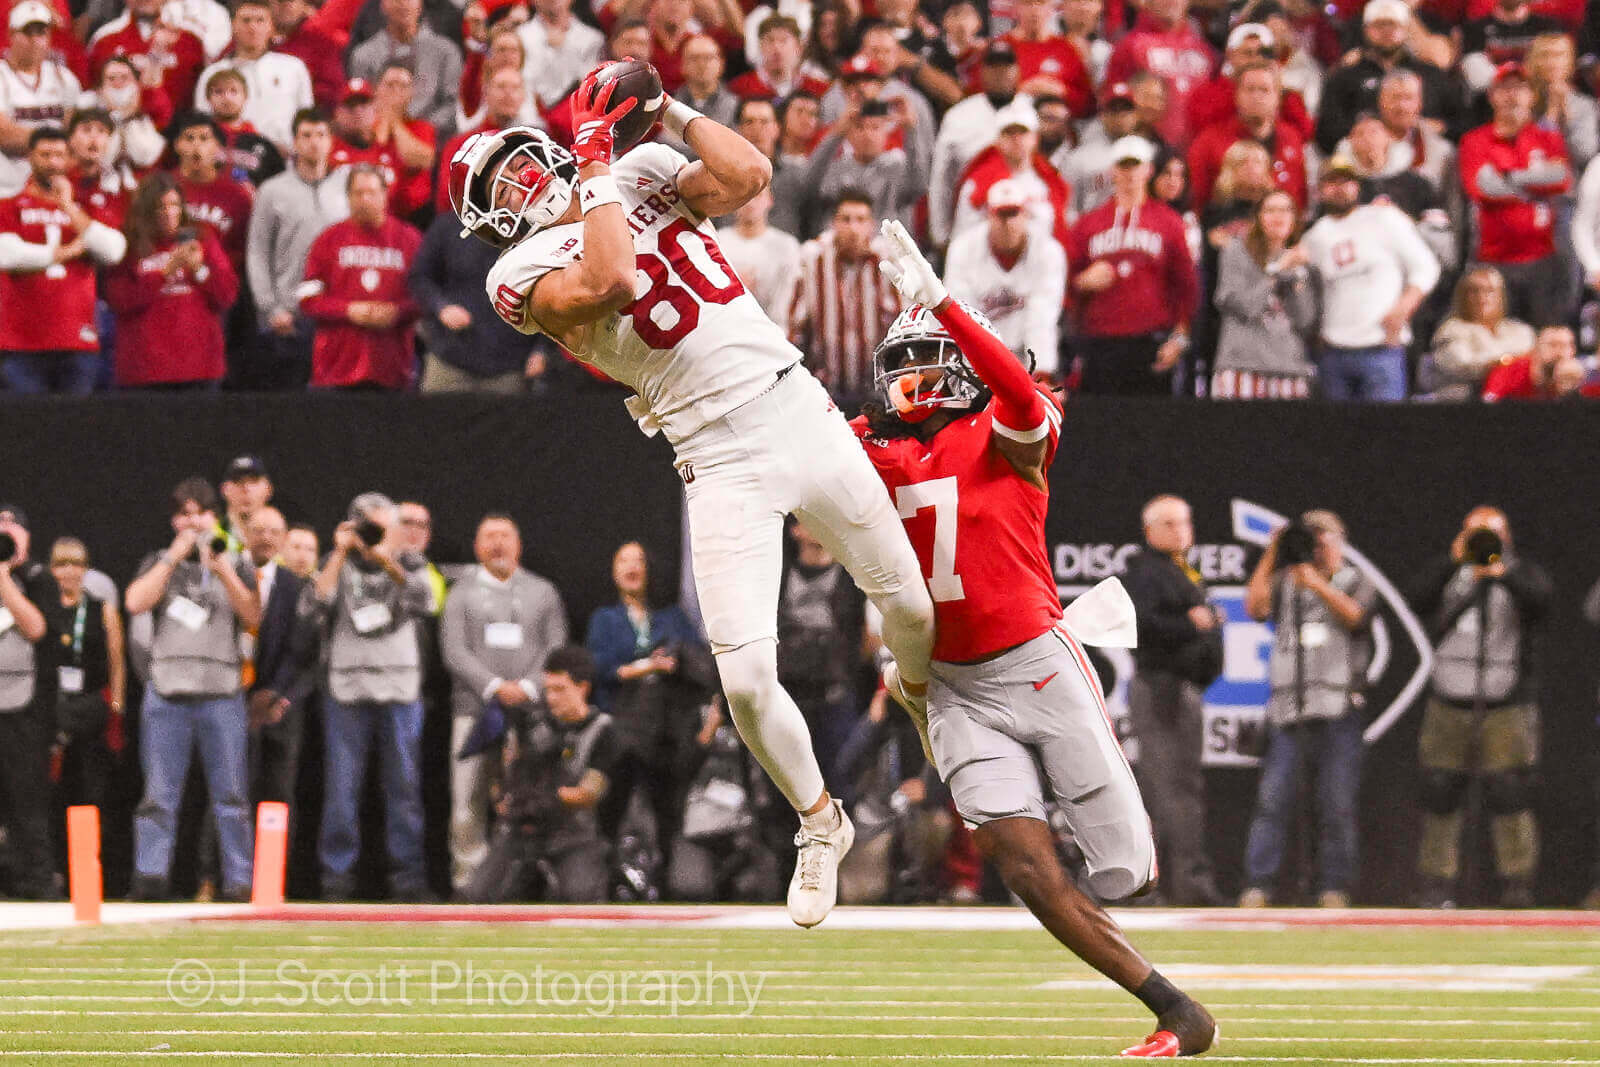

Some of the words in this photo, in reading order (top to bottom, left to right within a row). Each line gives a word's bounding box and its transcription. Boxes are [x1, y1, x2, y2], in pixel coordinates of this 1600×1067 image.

[626, 183, 680, 236] IERS
[495, 284, 526, 325] 80
[618, 216, 745, 350] 80
[895, 475, 966, 602] 7
[1054, 543, 1246, 579] DISCER
